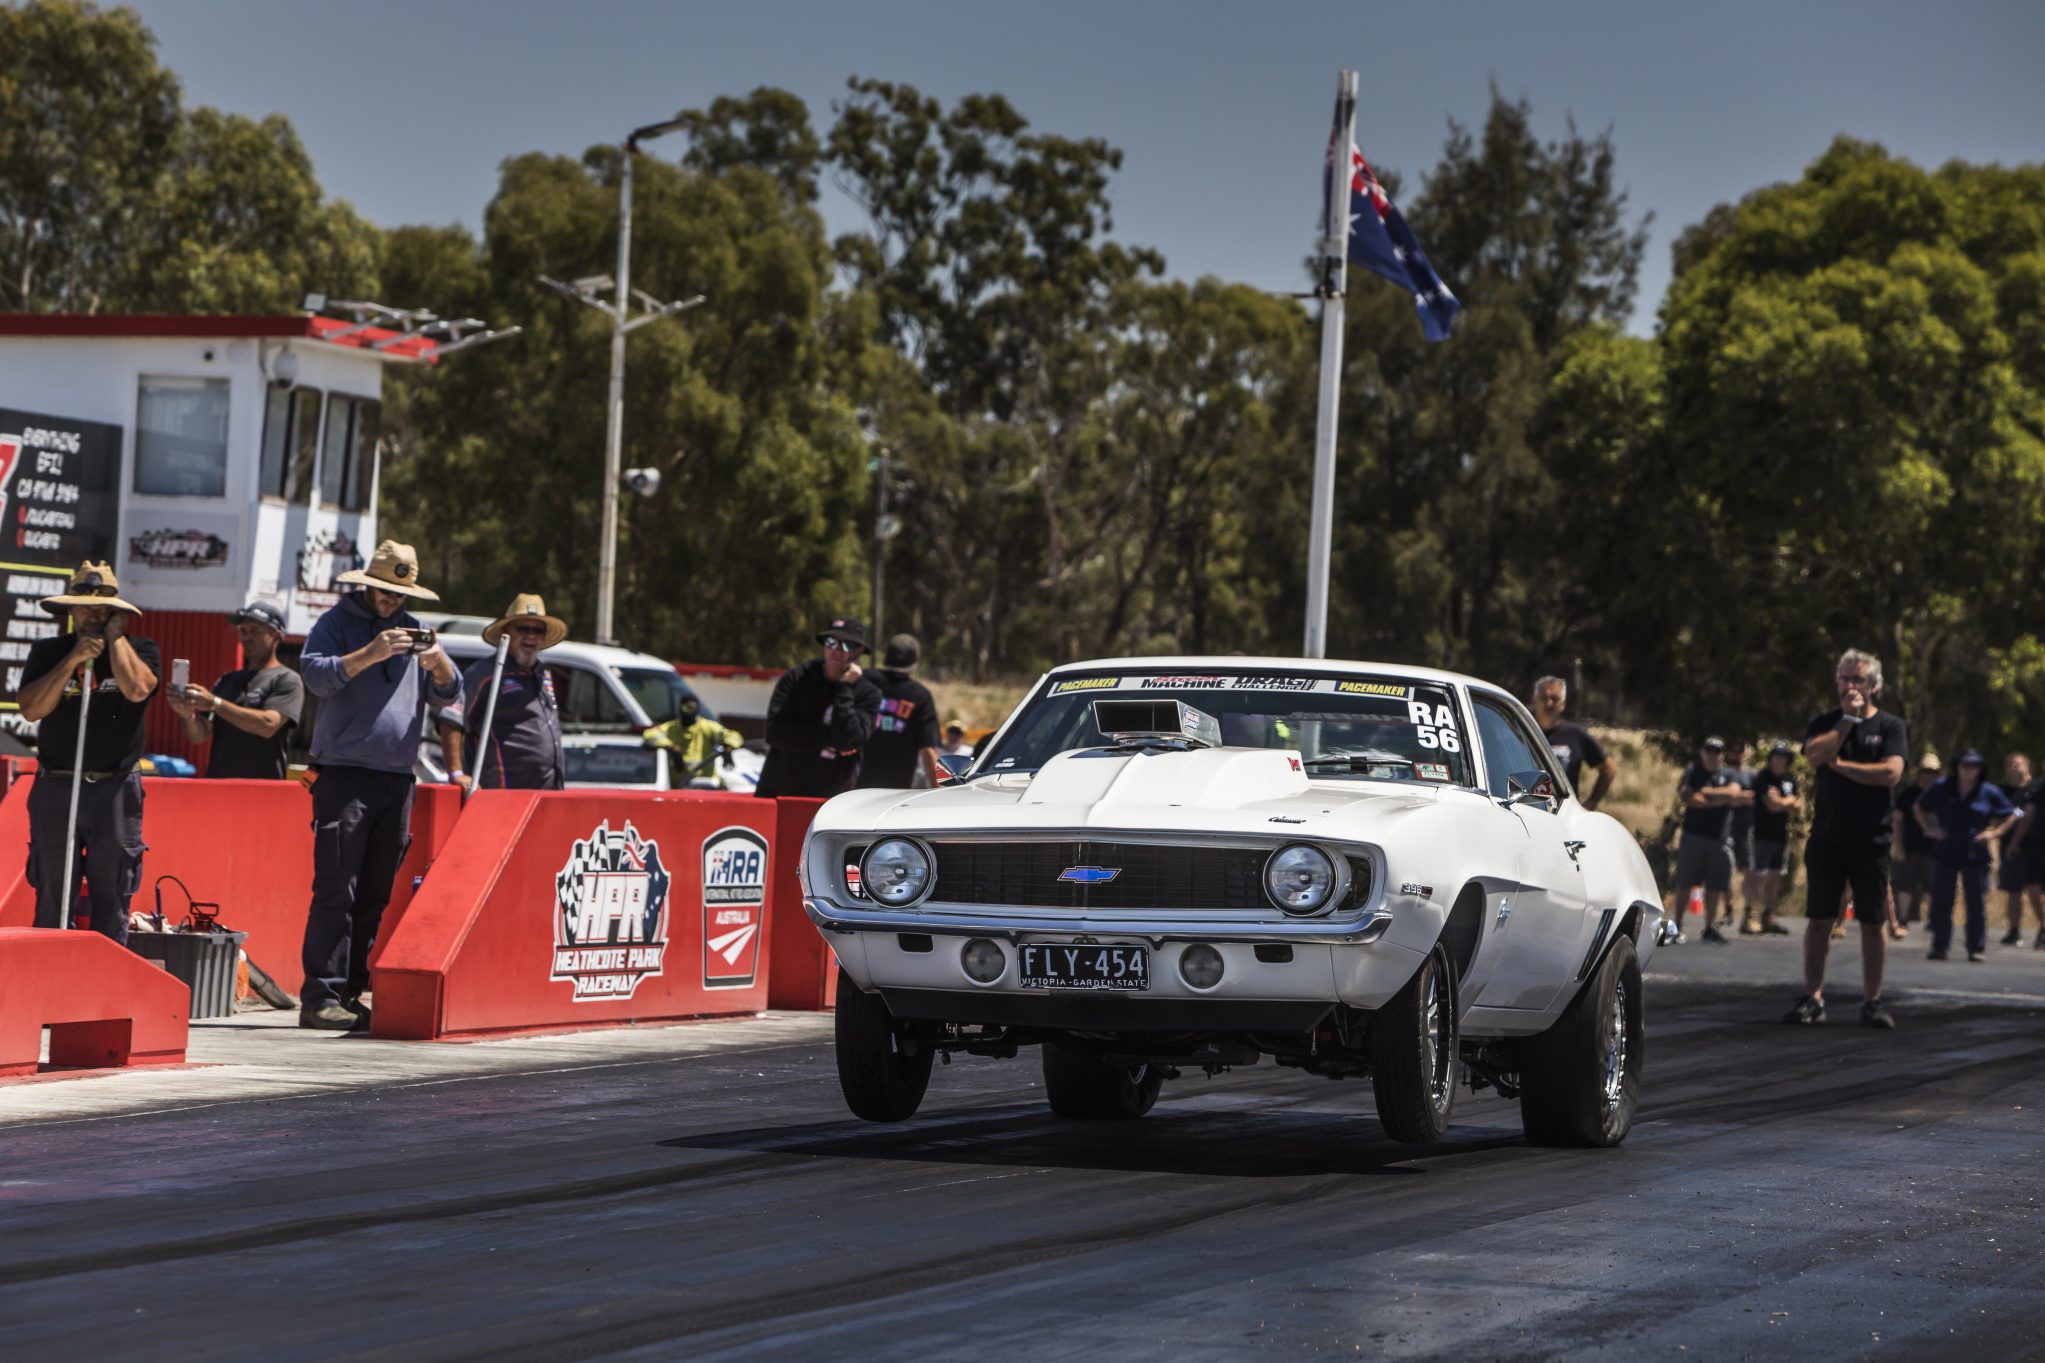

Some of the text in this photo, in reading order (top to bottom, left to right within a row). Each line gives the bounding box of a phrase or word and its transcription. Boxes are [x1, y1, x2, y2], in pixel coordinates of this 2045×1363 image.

[1057, 677, 1118, 692] PACEMAKER
[1140, 678, 1227, 689] MACHINE
[1338, 681, 1406, 697] PACEMAKER
[1407, 701, 1456, 729] RA
[1416, 726, 1460, 753] 56
[1404, 882, 1422, 894] 396
[574, 871, 651, 944] HPR
[555, 947, 663, 971] HEATHCOTE PARK
[577, 973, 637, 994] RACEWAY
